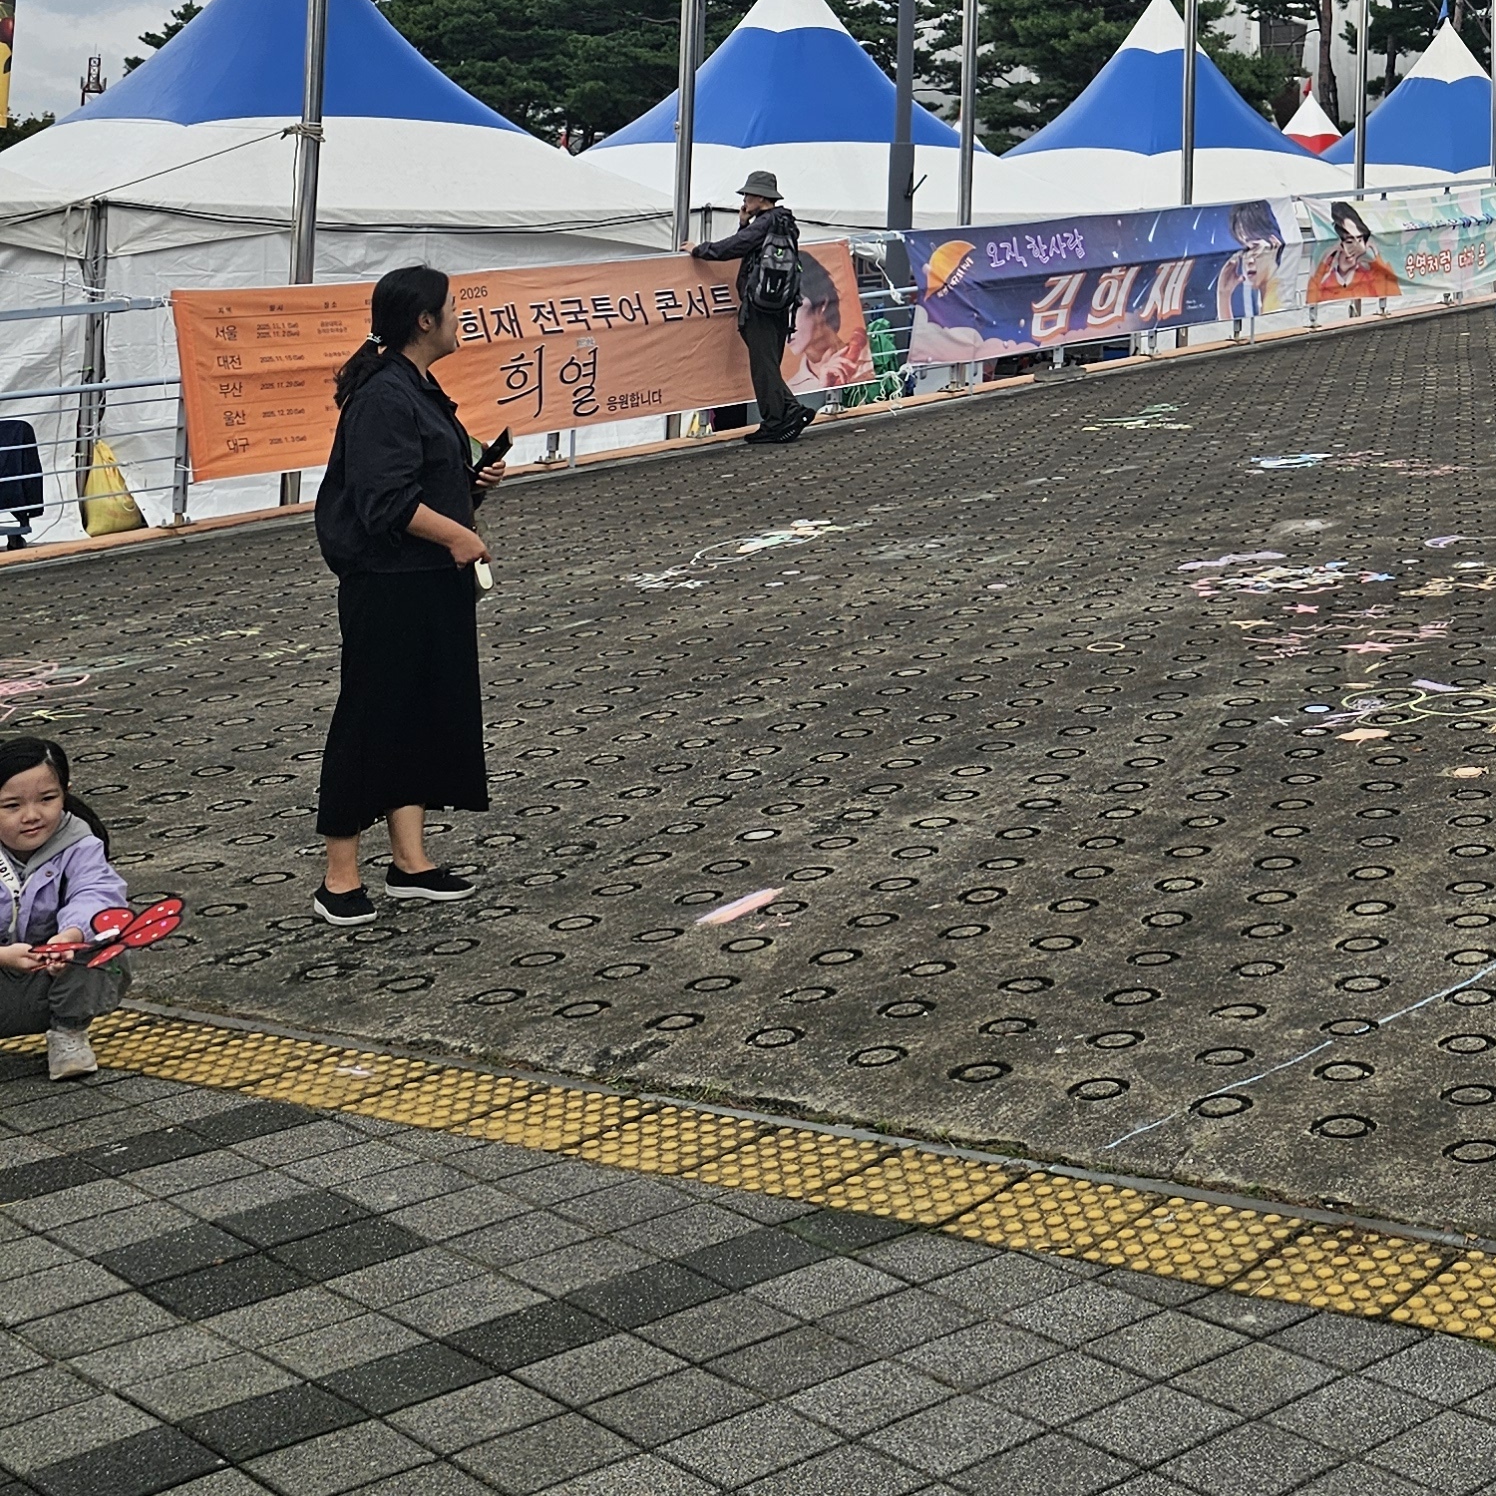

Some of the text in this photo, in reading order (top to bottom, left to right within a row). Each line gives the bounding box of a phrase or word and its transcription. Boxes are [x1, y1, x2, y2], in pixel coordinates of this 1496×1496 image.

[986, 228, 1086, 267] 오직 한사람
[1405, 248, 1452, 279] 운명처럼
[459, 286, 488, 301] 2026
[1031, 258, 1196, 341] 김희재
[455, 284, 738, 347] 희재 전국투어 콘서트
[215, 324, 239, 342] 서울
[217, 355, 243, 370] 대전
[219, 382, 243, 398] 부산
[606, 389, 662, 412] 응원합니다
[223, 410, 246, 426] 울산
[226, 437, 250, 454] 대구
